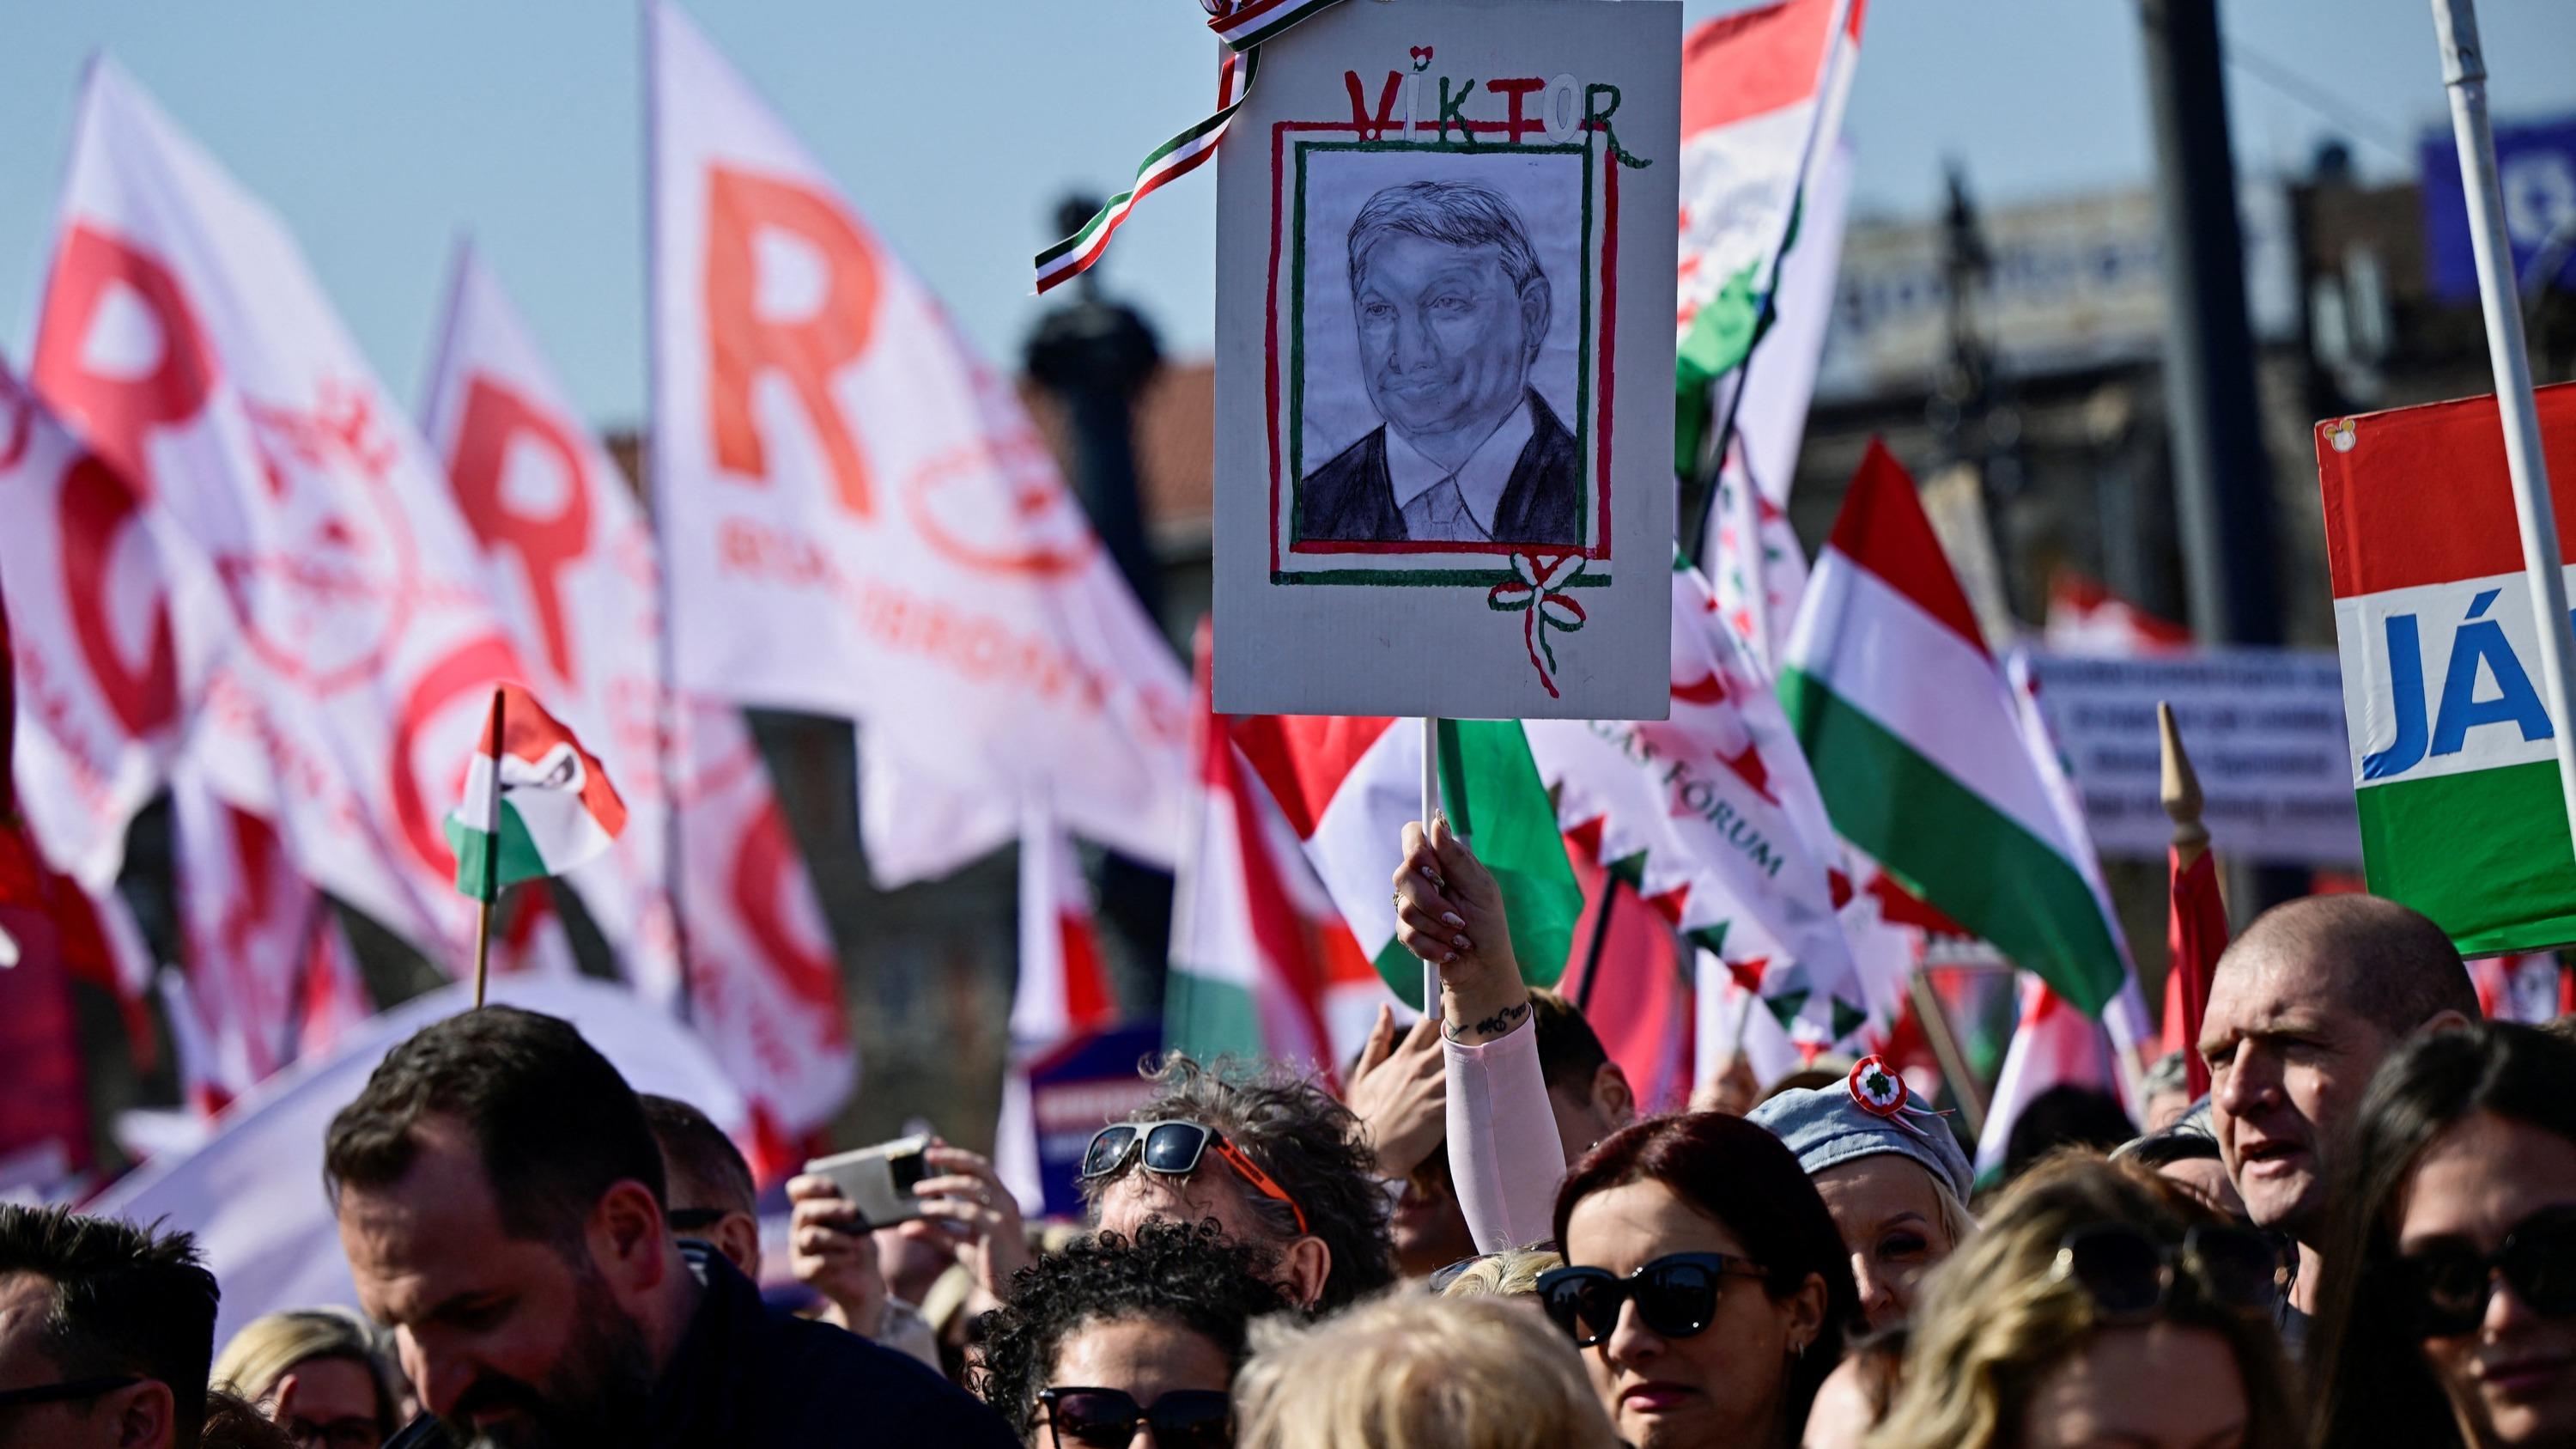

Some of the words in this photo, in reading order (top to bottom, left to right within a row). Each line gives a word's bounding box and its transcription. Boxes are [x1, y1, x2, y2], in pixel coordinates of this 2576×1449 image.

[704, 165, 881, 520] R
[2362, 588, 2576, 781] JÁ
[1662, 759, 1784, 878] FÓRUM
